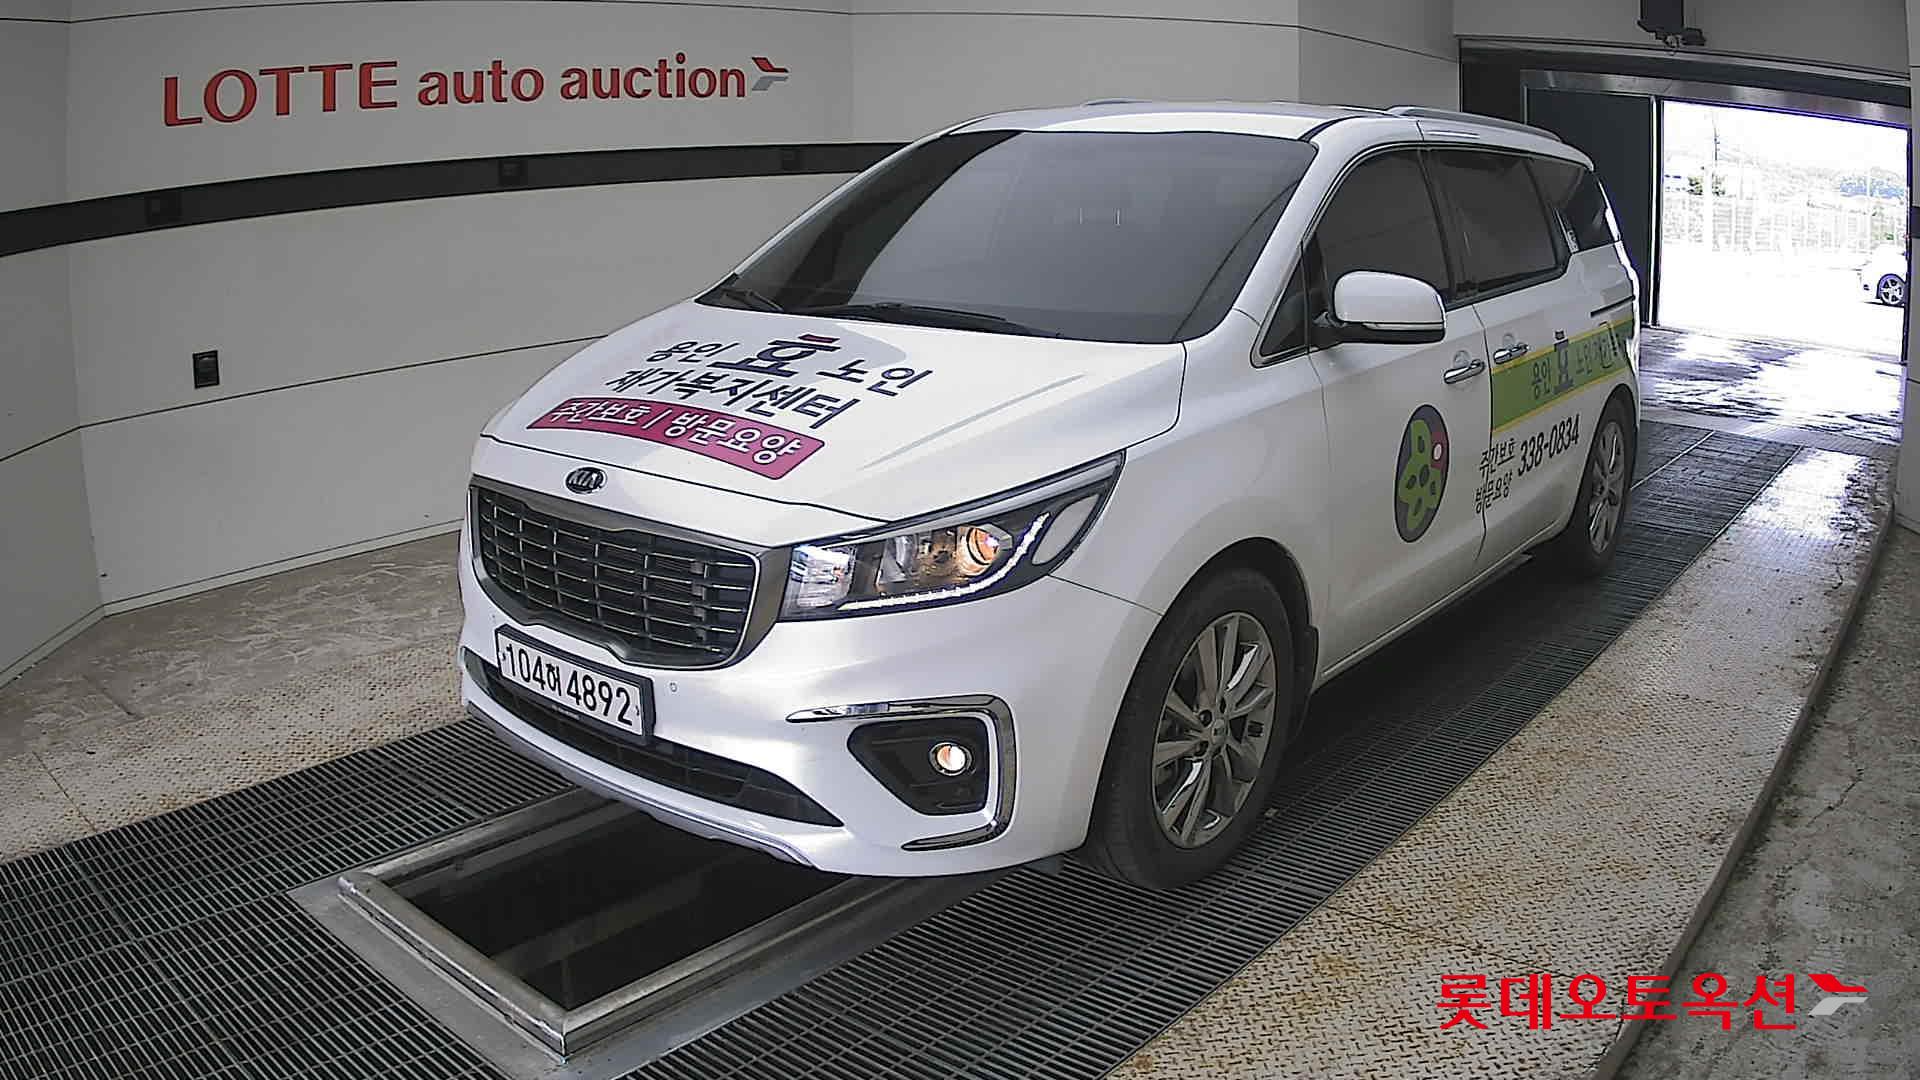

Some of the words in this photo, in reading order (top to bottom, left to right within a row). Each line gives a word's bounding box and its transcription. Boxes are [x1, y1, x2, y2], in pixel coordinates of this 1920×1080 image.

[164, 60, 399, 127] LOTTE
[416, 60, 545, 106] auto
[560, 52, 747, 101] auction
[645, 340, 740, 363] 용인
[706, 333, 841, 379] 효
[815, 358, 933, 397] 노인
[604, 367, 860, 429] 재가복지센터
[663, 412, 808, 466] 방문요양
[1518, 413, 1580, 477] 338-0834
[566, 669, 633, 727] 4892
